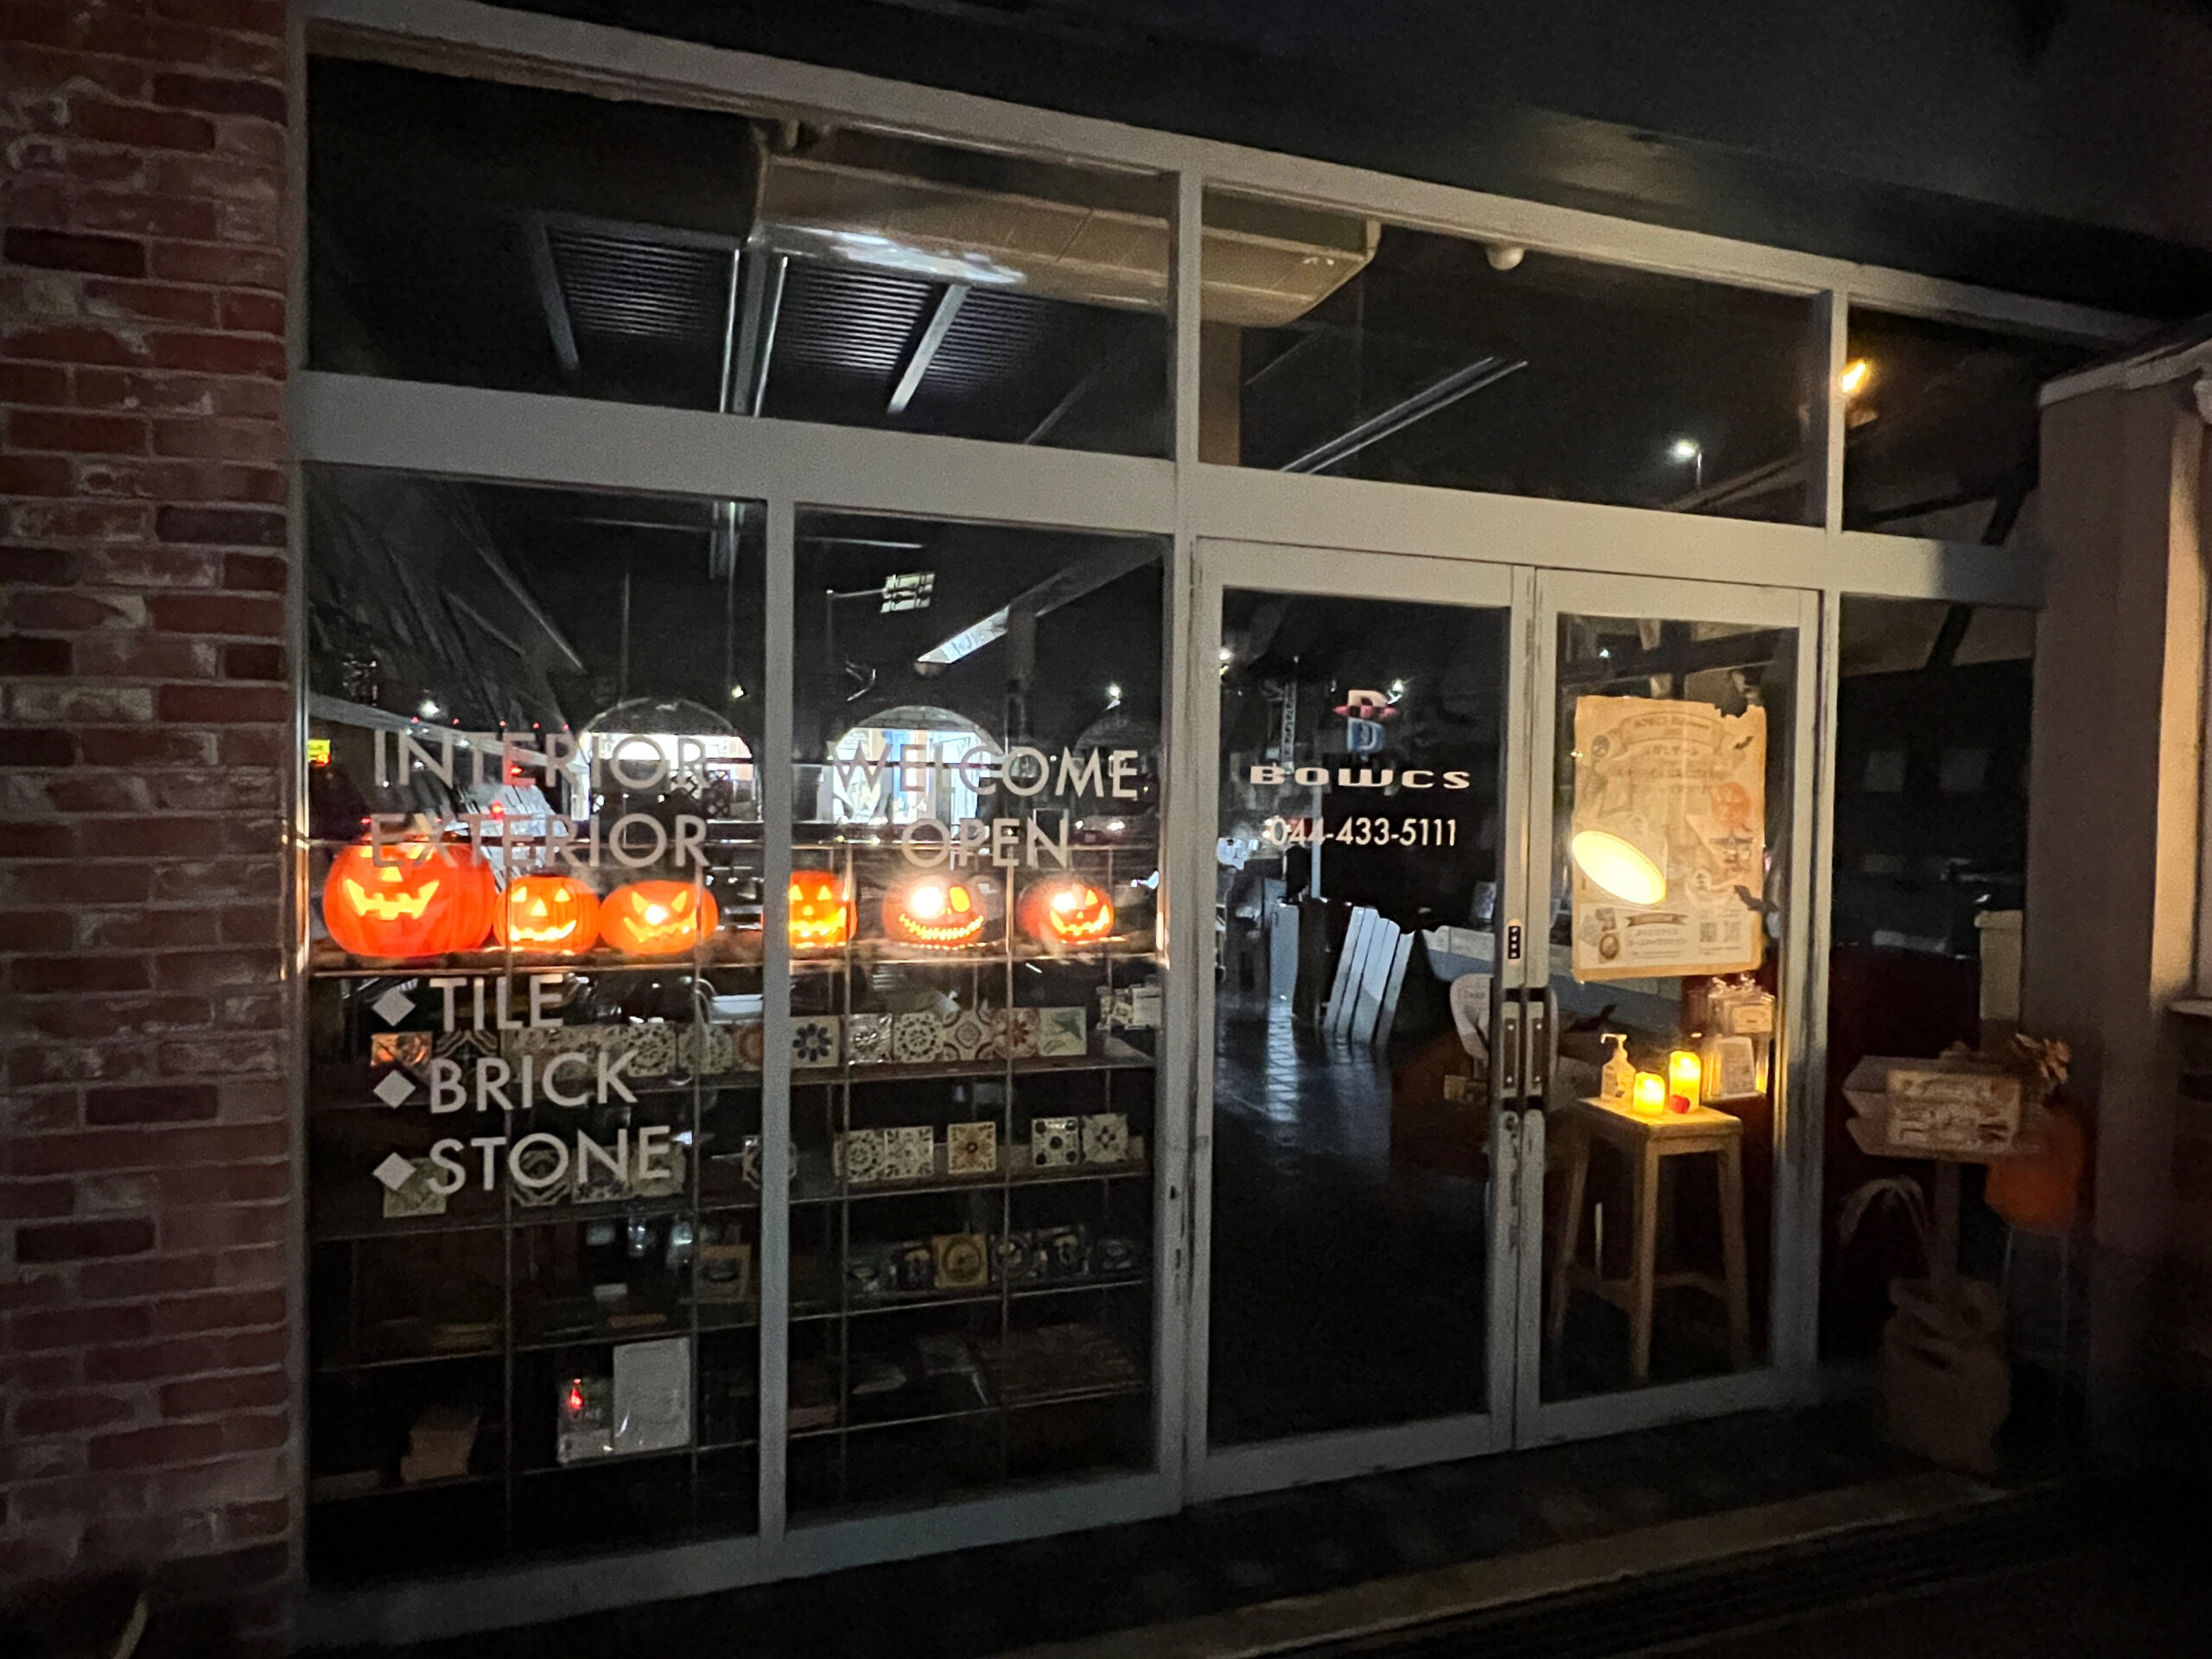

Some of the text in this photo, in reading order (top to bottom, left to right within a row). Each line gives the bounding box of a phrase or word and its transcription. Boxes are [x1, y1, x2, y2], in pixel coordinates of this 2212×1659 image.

[374, 728, 709, 789] INTERIOR
[832, 741, 1139, 798] WELCOME
[371, 812, 710, 868] EXTERIOR
[901, 813, 1071, 869] OPEN
[1268, 816, 1457, 846] 044-433-5111
[429, 974, 564, 1032] TILE
[430, 1049, 639, 1114] BRICK
[427, 1125, 671, 1194] STONE
